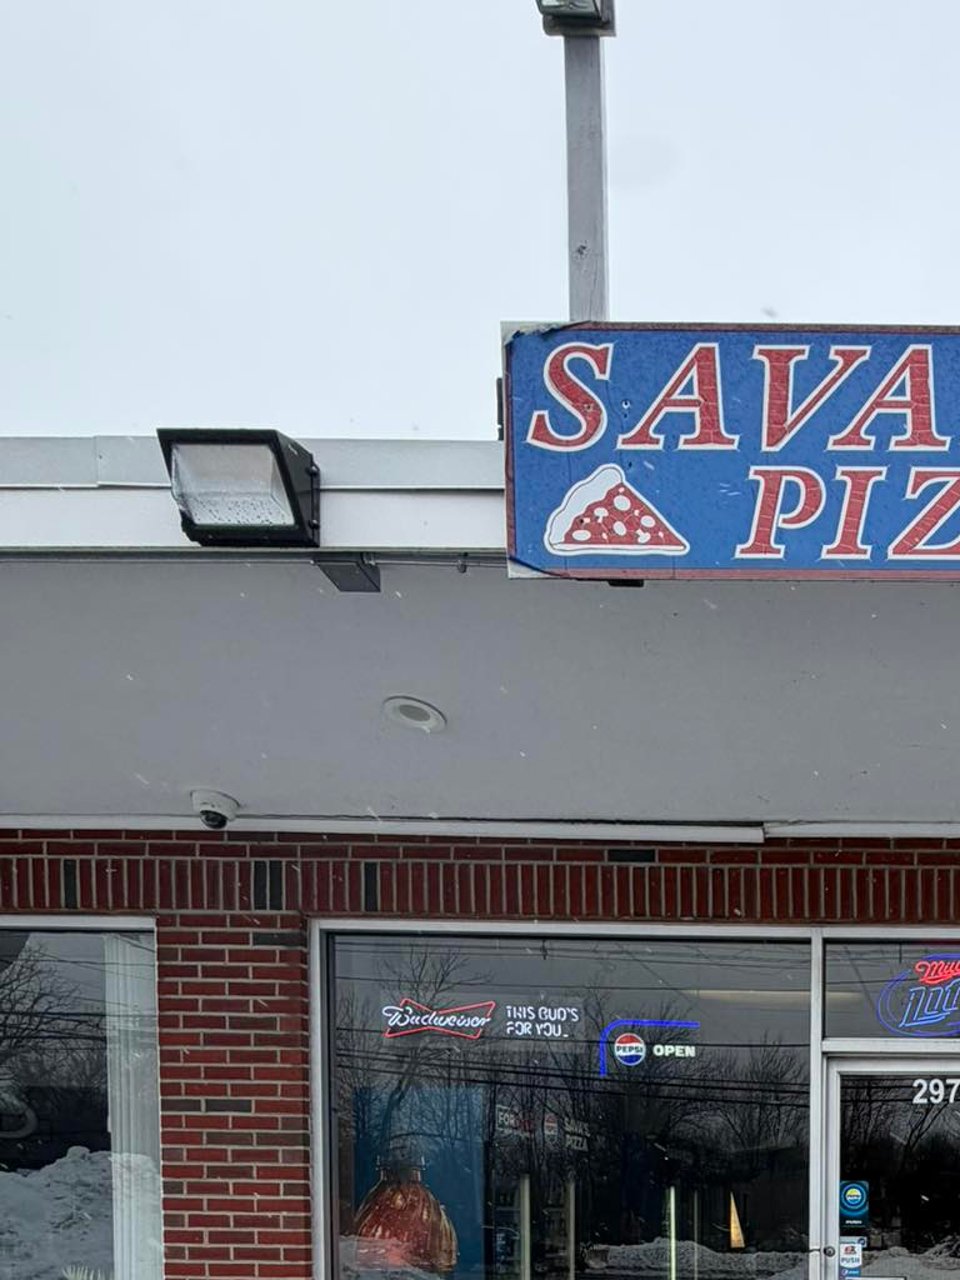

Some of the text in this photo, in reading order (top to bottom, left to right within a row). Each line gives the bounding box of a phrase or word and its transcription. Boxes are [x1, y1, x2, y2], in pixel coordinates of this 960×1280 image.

[381, 1005, 490, 1028] Budweiser
[506, 1005, 535, 1021] THIS
[506, 1021, 532, 1036] FOR
[653, 1044, 696, 1057] OPEN
